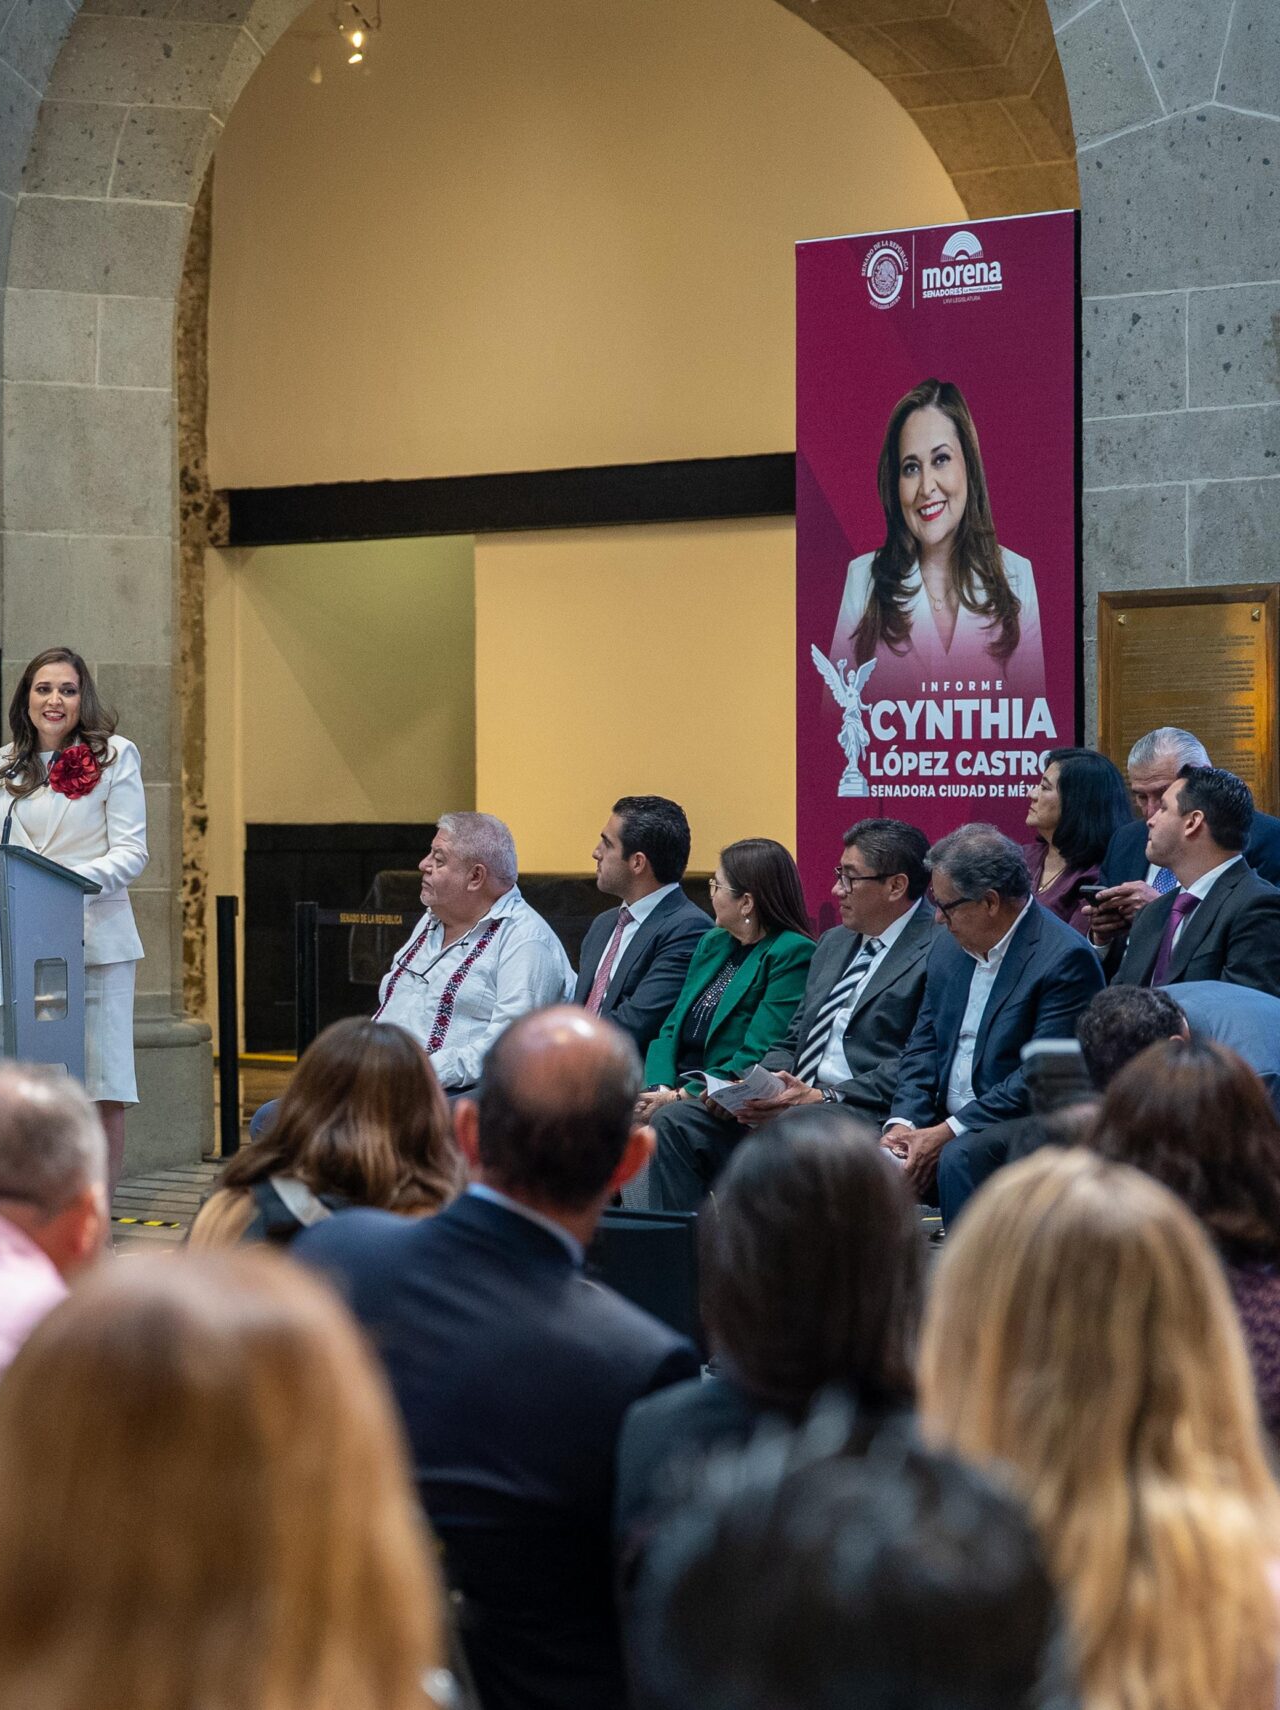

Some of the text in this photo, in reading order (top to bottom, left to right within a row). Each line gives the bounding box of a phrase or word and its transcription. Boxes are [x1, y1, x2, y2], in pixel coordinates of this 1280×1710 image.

[873, 241, 881, 250] DE
[922, 261, 1002, 290] morena
[922, 286, 963, 299] SENADORES
[921, 680, 1003, 692] INFORME
[870, 697, 1057, 741] CYNTHIA
[870, 745, 949, 776] LÓPEZ
[871, 784, 936, 797] SENADORA
[939, 784, 986, 797] CIUDAD
[989, 784, 1005, 797] DE
[360, 913, 368, 924] DE
[368, 914, 375, 924] LA
